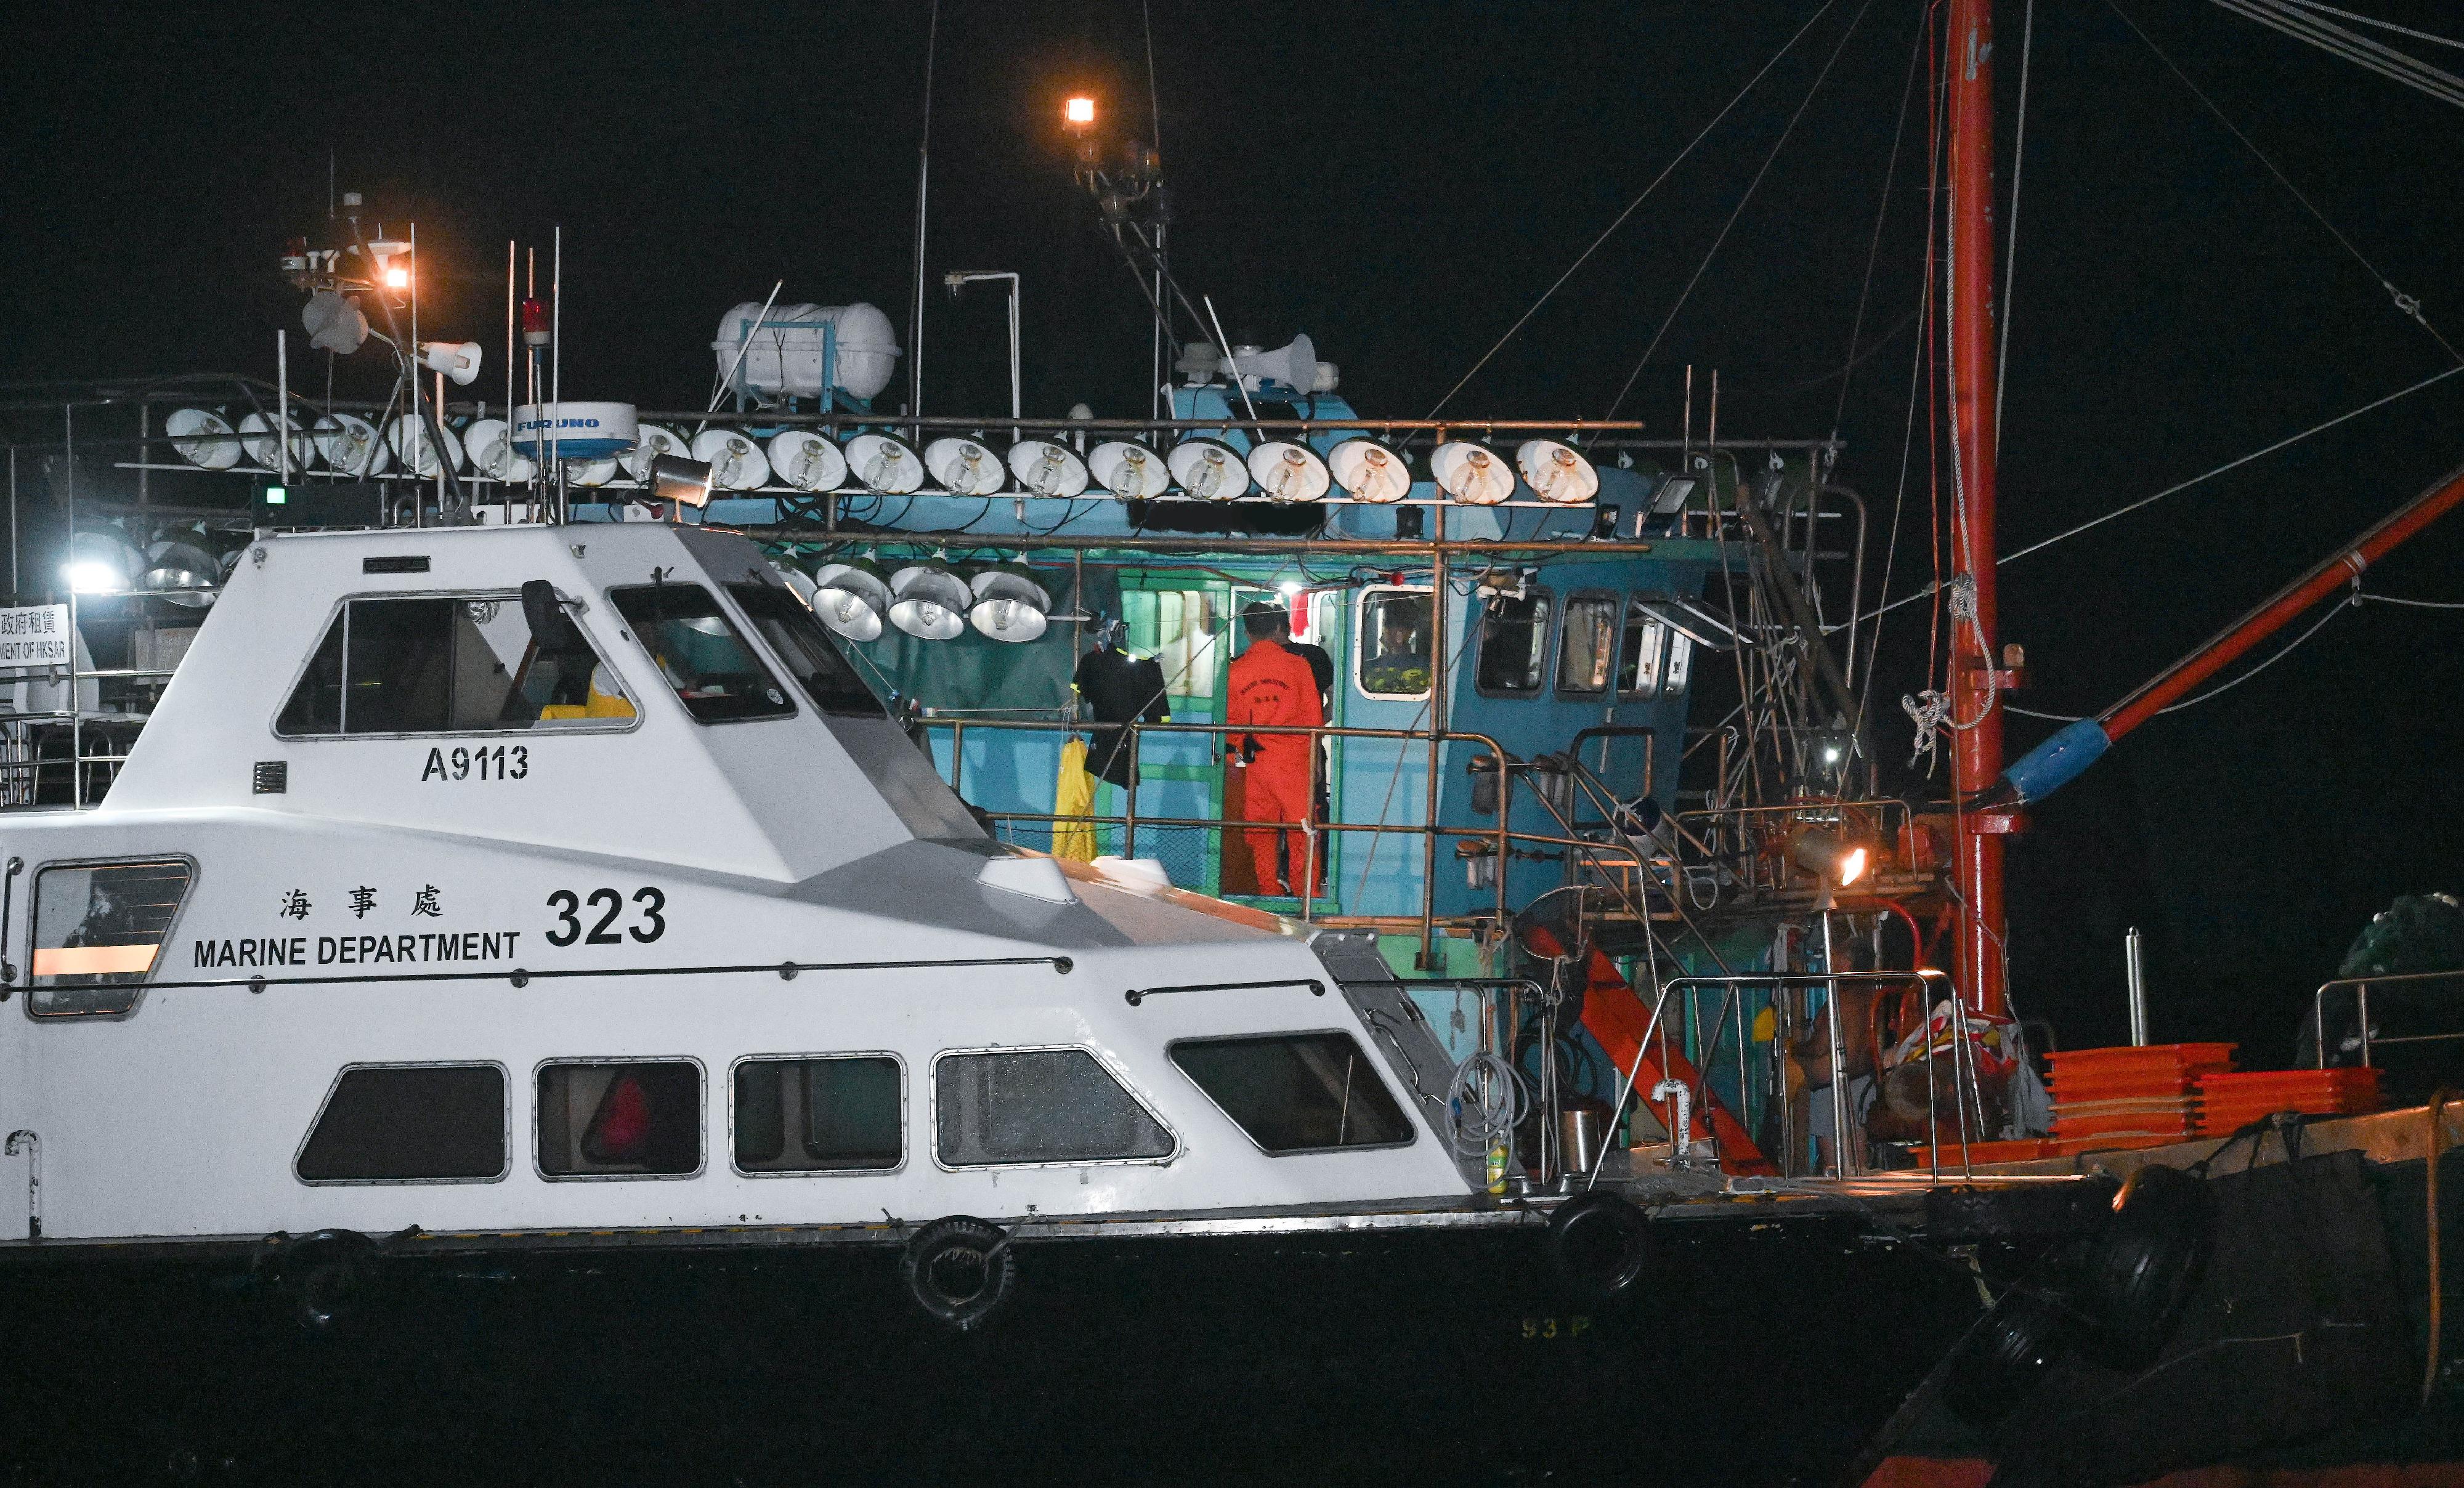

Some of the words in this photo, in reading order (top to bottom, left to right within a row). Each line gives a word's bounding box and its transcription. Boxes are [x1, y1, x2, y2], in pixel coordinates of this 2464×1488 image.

[517, 419, 600, 432] FURUNO
[1, 610, 55, 635] 政府租賃
[23, 641, 34, 659] OF
[36, 641, 65, 658] HKSAR
[421, 745, 528, 782] A9113
[545, 886, 666, 947] 323
[194, 937, 306, 968] MARINE
[318, 931, 521, 964] DEPARTMENT
